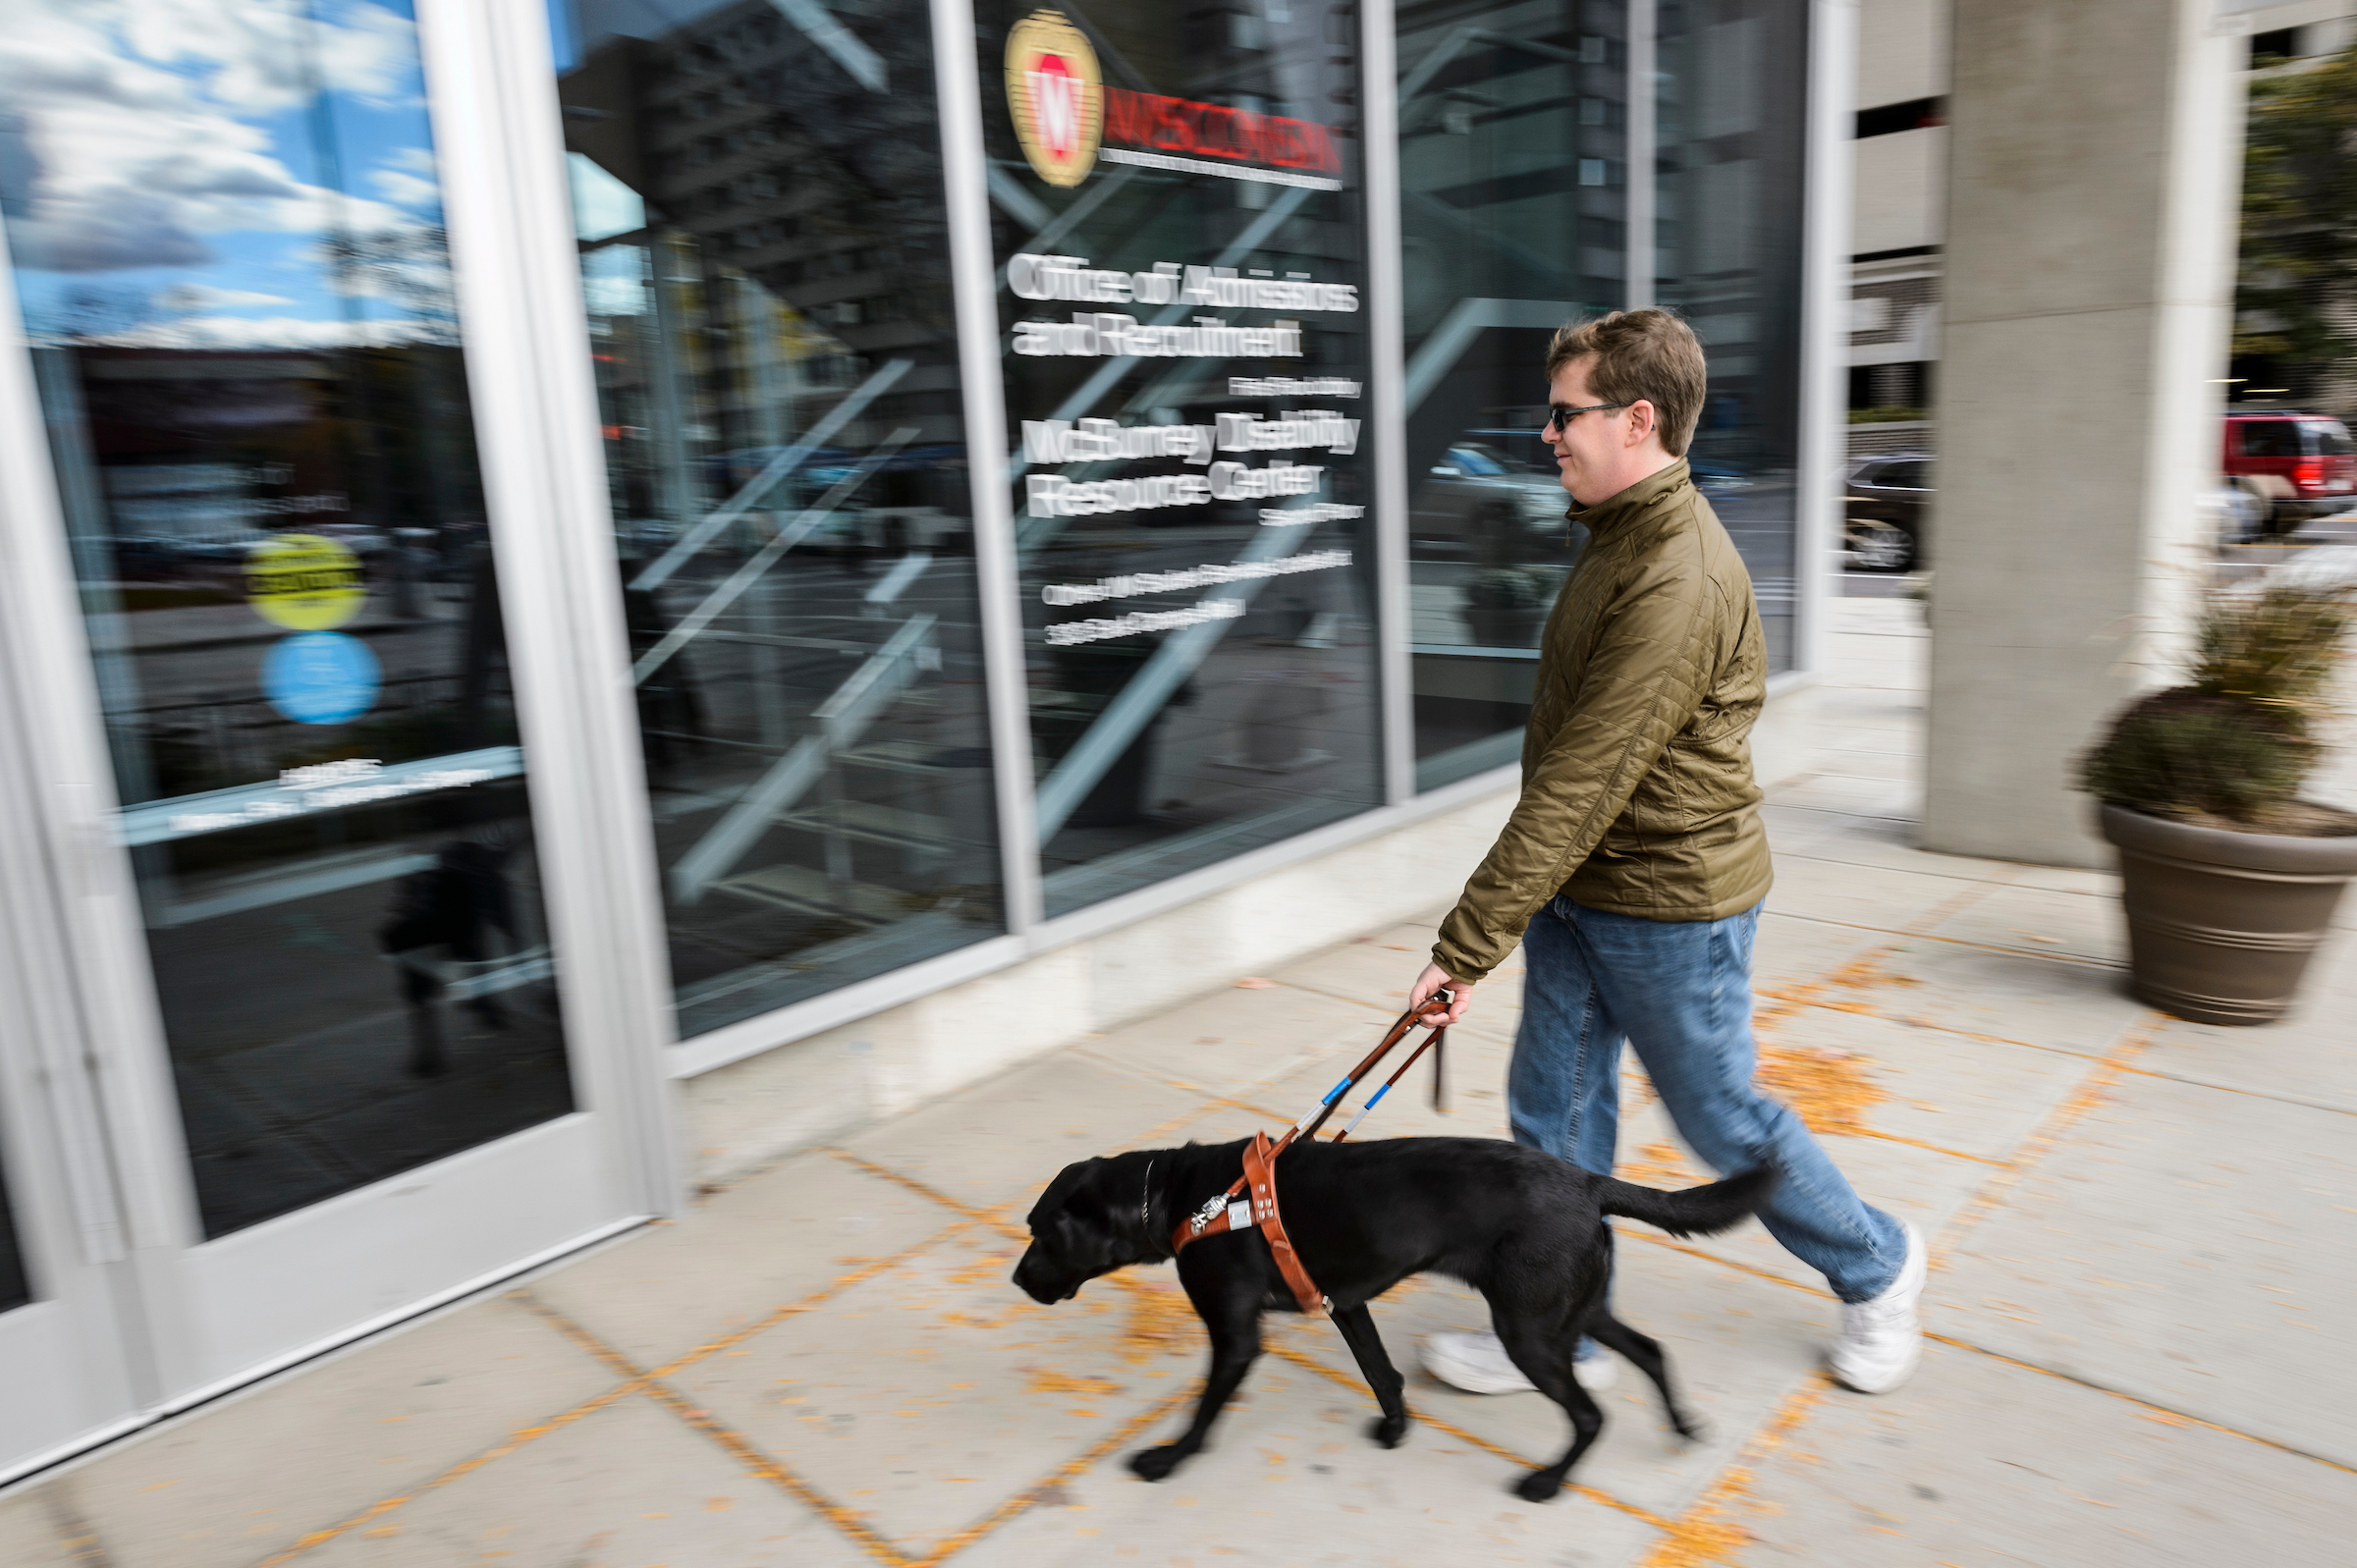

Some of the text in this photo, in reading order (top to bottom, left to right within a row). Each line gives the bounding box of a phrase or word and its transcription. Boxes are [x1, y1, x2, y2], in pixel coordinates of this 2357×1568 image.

[1101, 85, 1343, 175] WISCONSIN
[1008, 252, 1359, 313] Office of Admissions
[1012, 311, 1303, 357] and Recruitment
[1021, 409, 1361, 464] McBurney Disability
[1025, 460, 1325, 517] Resource Center
